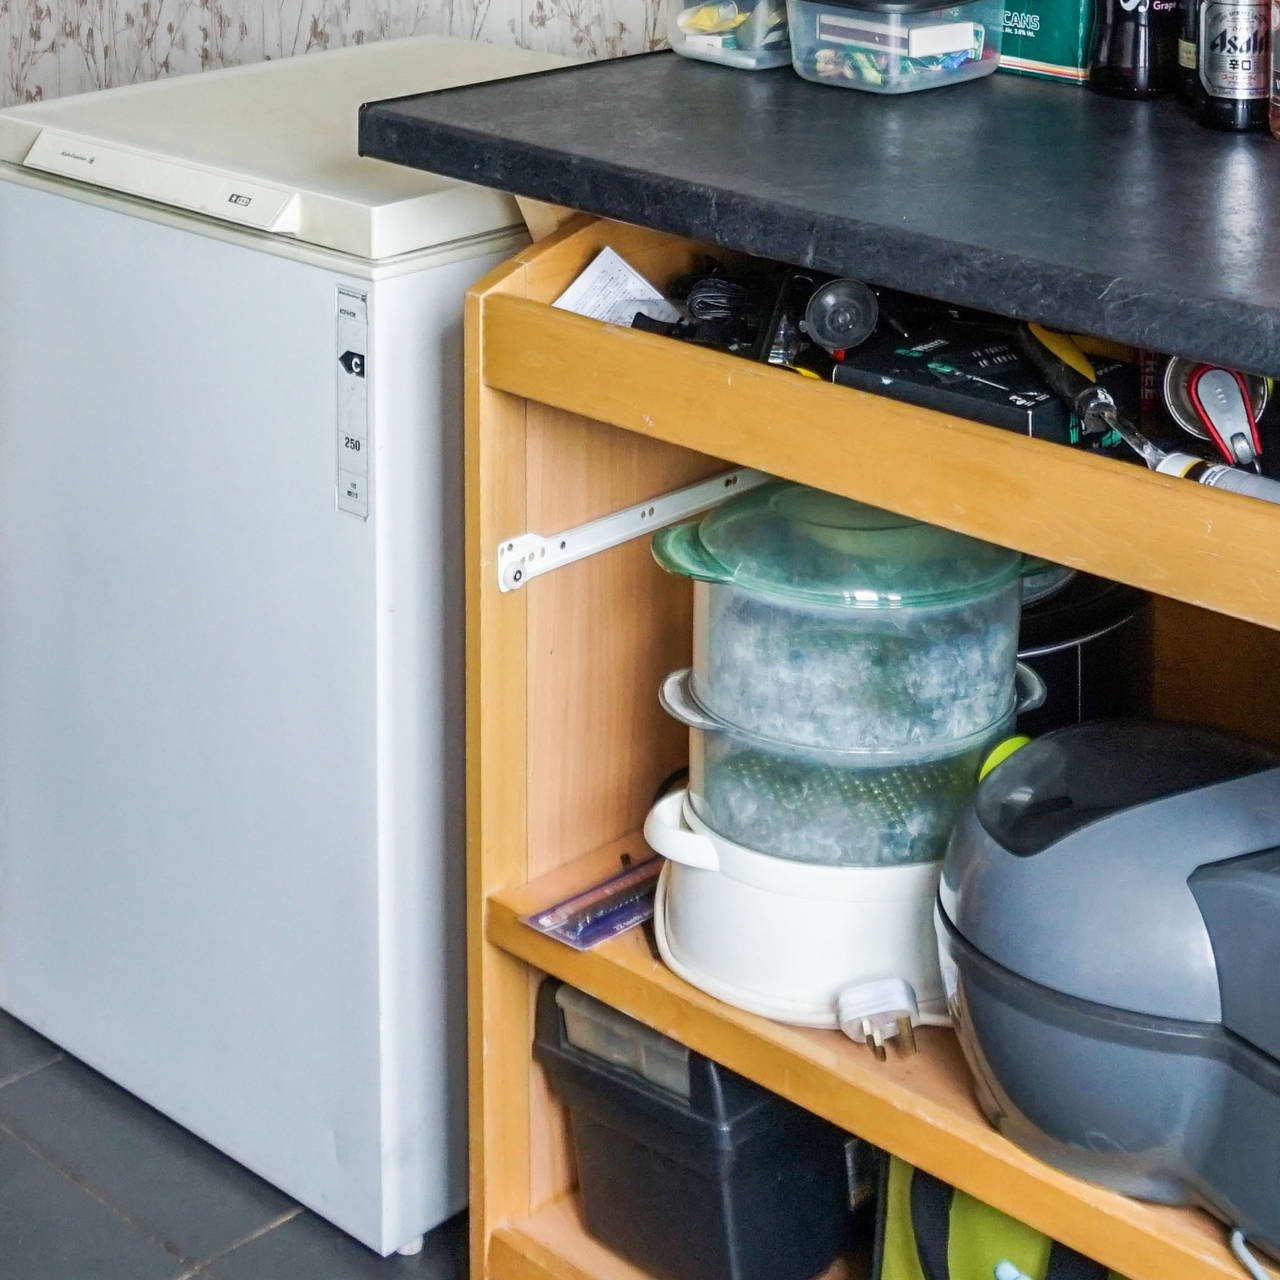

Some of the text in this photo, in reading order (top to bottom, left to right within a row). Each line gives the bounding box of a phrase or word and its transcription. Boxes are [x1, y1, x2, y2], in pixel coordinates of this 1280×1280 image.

[1003, 10, 1040, 31] CANS
[351, 357, 361, 373] C
[345, 436, 361, 452] 250
